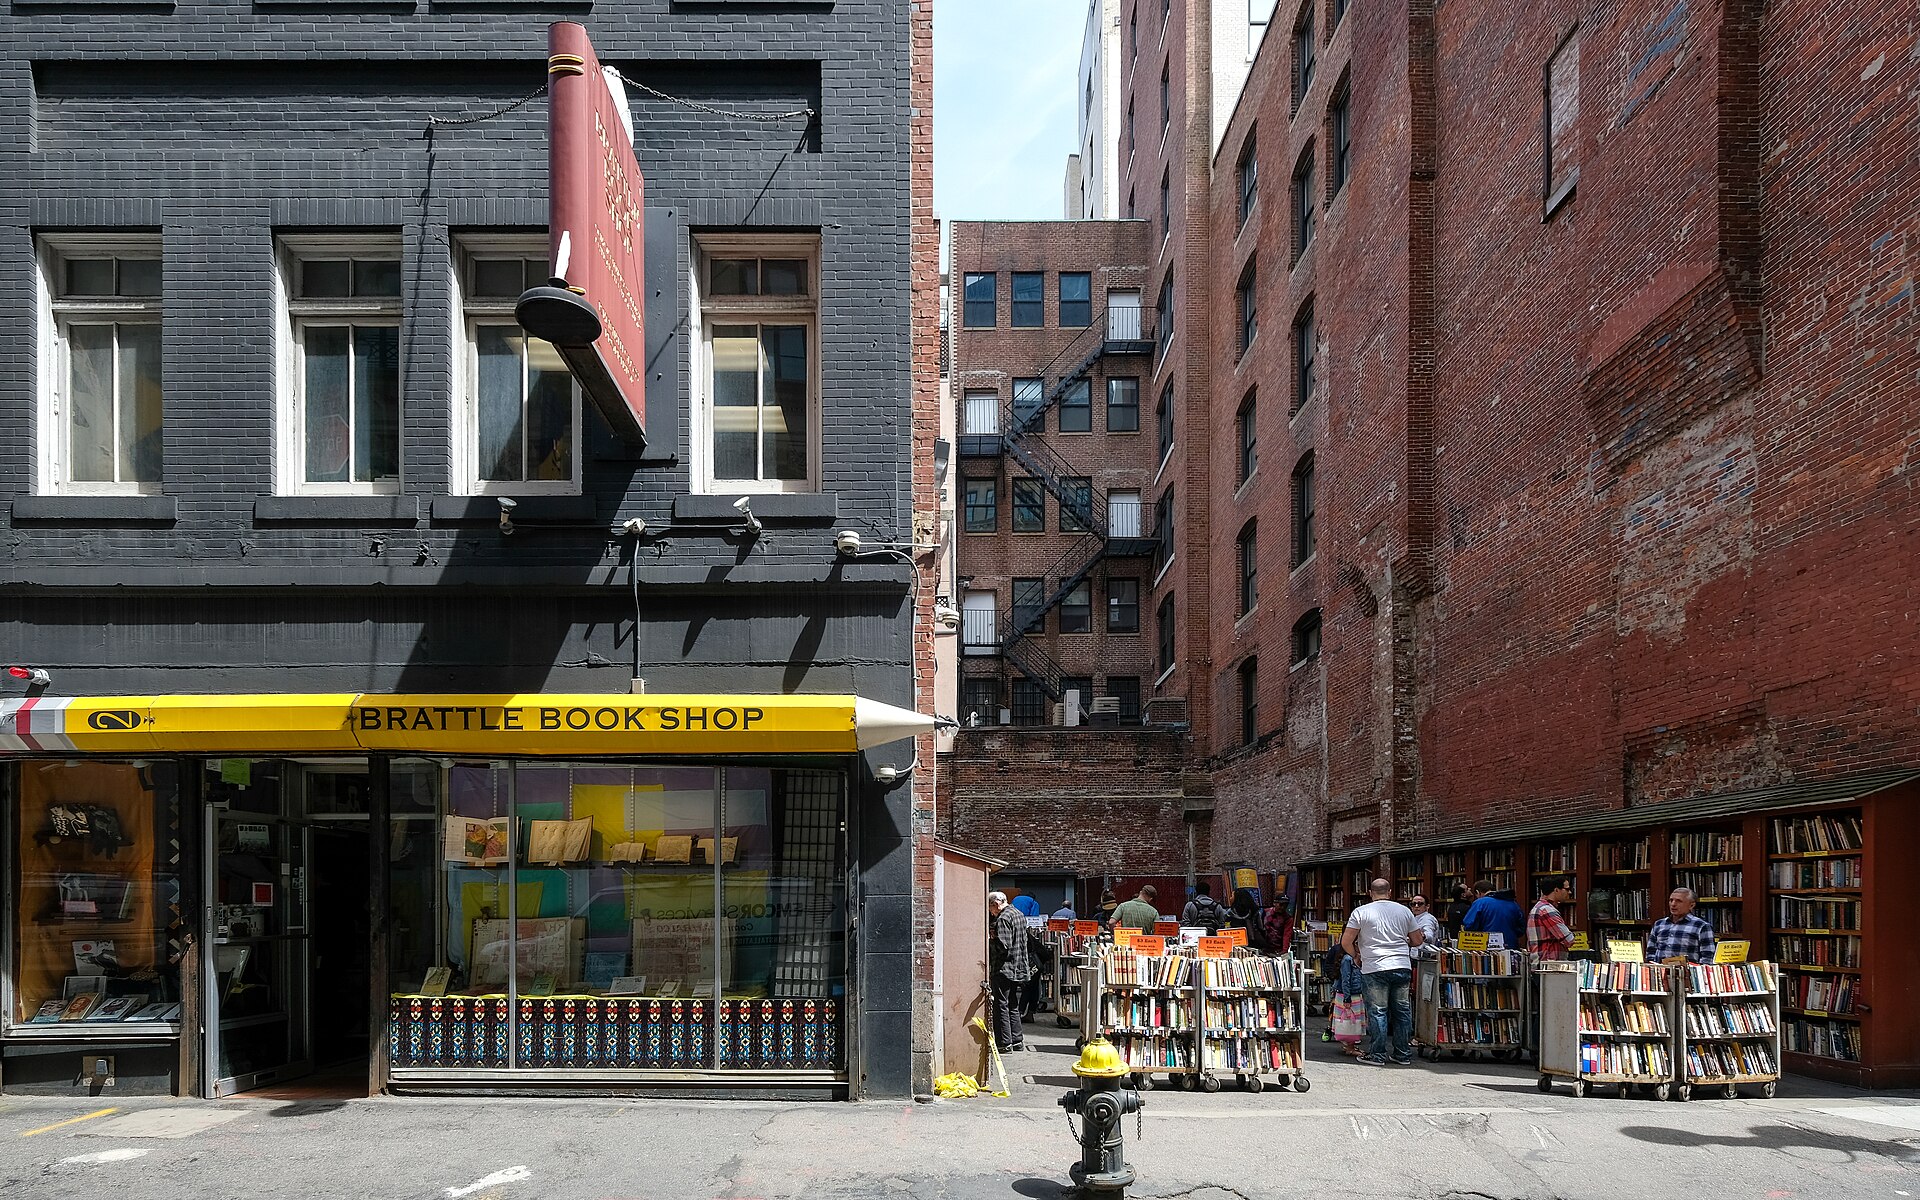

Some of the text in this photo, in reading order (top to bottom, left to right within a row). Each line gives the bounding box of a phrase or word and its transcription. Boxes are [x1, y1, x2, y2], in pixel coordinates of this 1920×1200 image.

[359, 707, 763, 731] BRATTLE BOOK SHOP
